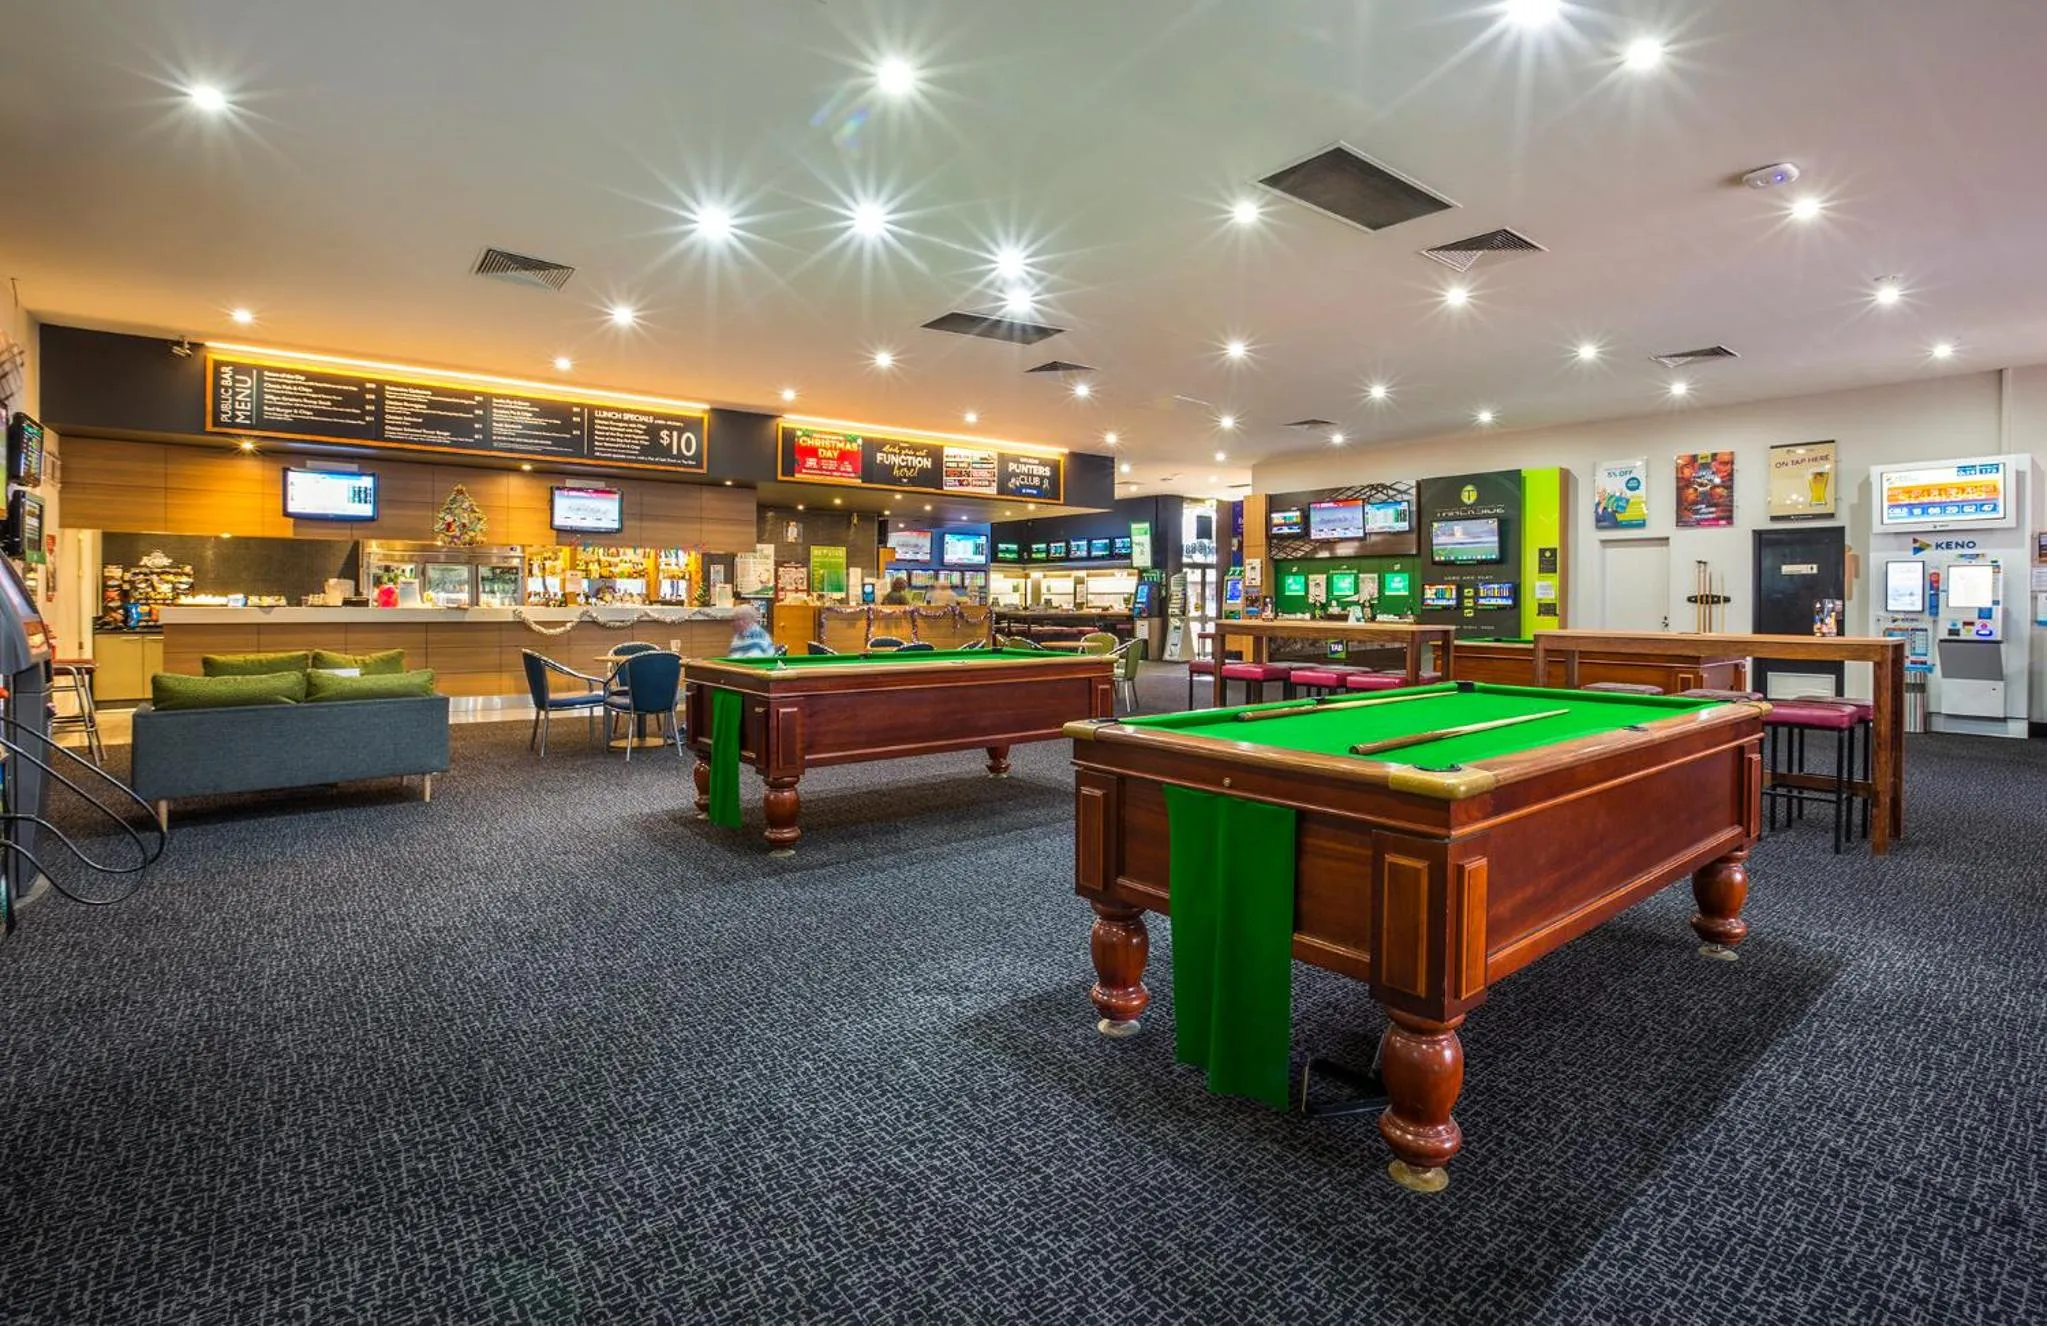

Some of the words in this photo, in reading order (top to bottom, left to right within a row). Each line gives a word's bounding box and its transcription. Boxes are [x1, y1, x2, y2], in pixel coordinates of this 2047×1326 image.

[221, 366, 233, 388] BAR
[220, 389, 232, 422] PUBLIC
[235, 375, 251, 424] MENU
[594, 410, 622, 420] LUNCH
[623, 413, 654, 423] SPECIALS
[660, 429, 697, 457] $10
[799, 436, 858, 452] CHRISTMAS
[818, 448, 840, 459] DAY
[876, 452, 932, 469] FUNCTION
[1791, 458, 1806, 466] TAP
[1807, 453, 1830, 462] HERE
[1008, 462, 1051, 477] PUNTERS
[1619, 470, 1633, 478] OFF
[1019, 475, 1041, 486] CLUB
[1935, 540, 1977, 550] KENO
[1330, 643, 1343, 652] TAB
